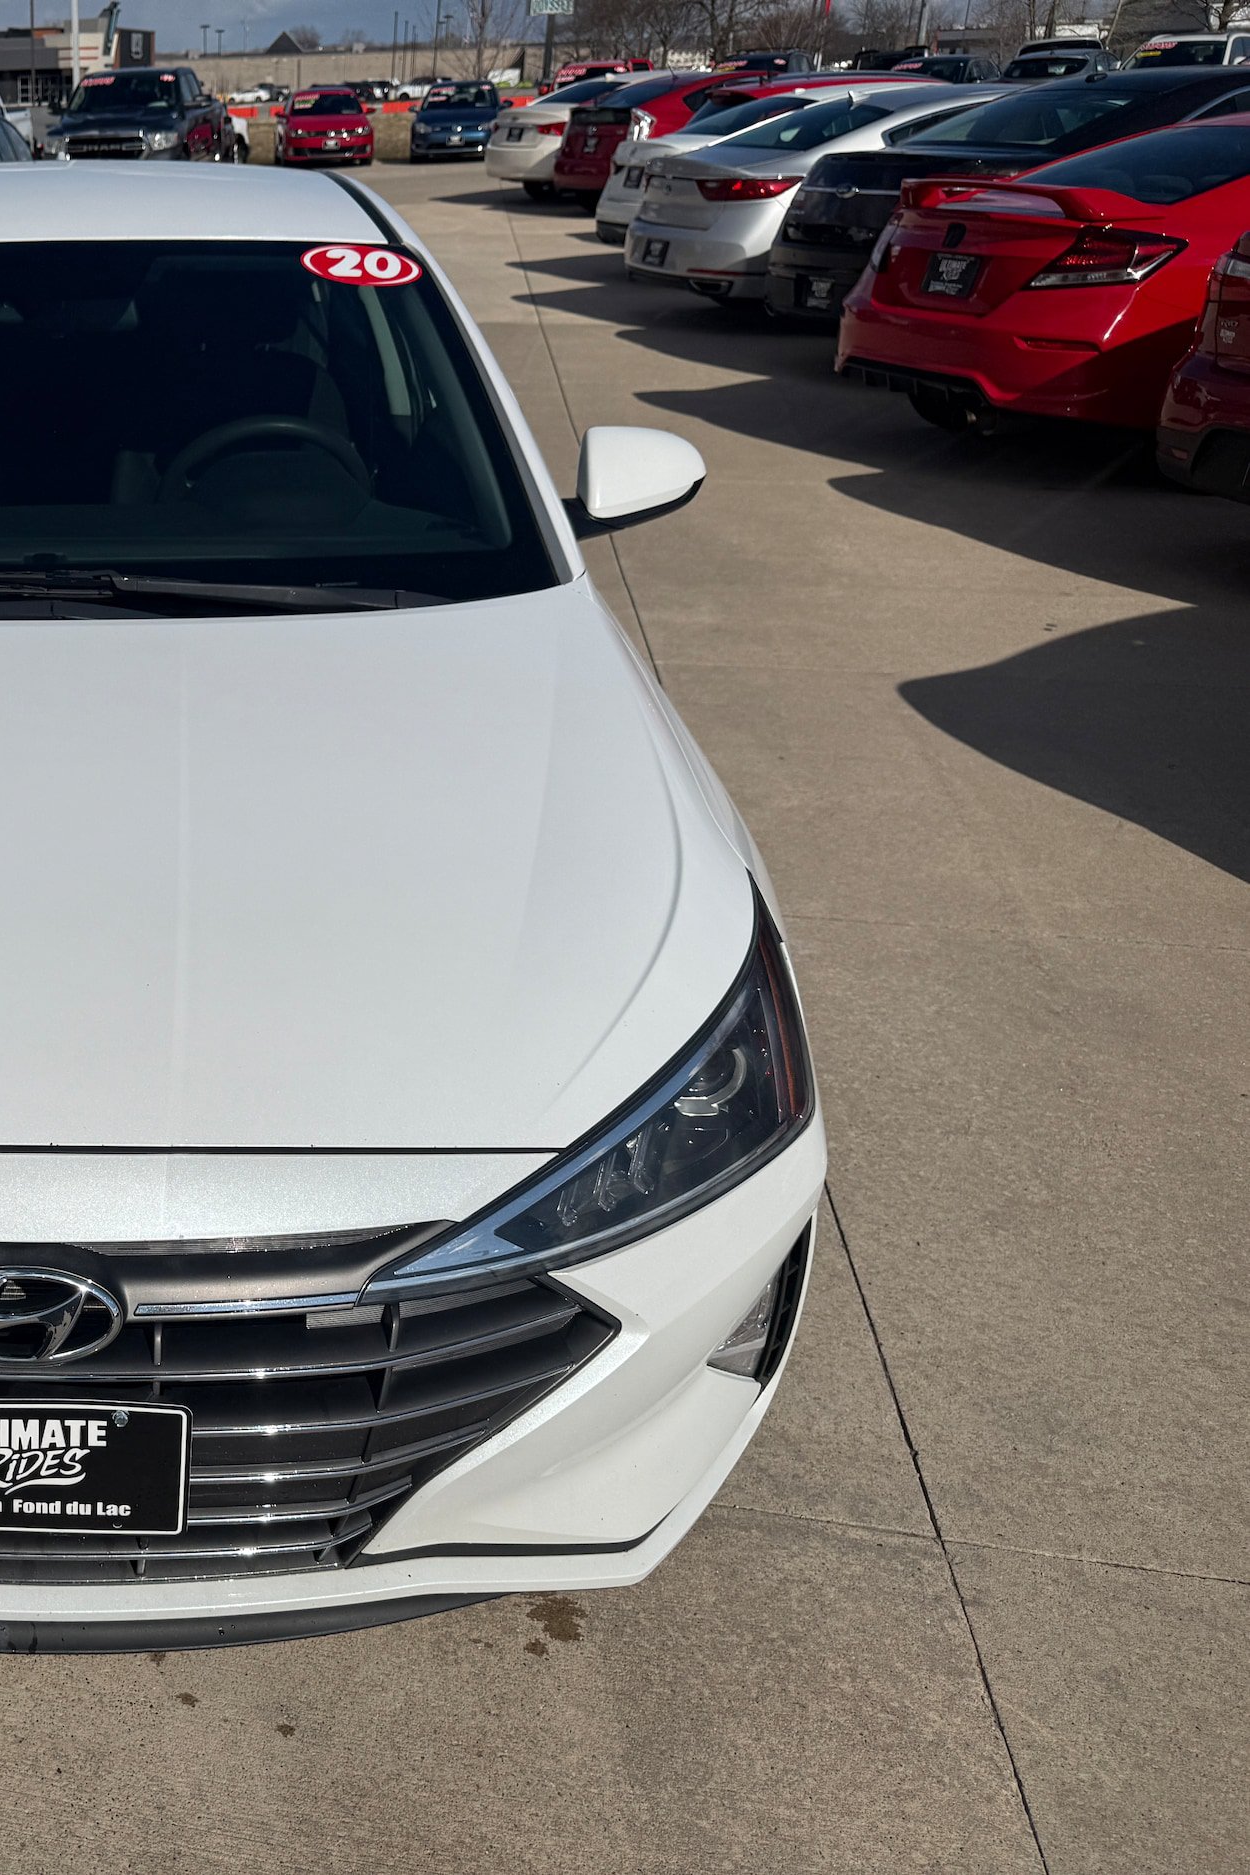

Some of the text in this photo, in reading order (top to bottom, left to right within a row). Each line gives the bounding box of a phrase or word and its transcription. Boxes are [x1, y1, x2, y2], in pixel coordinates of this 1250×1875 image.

[325, 248, 402, 279] 20
[13, 1499, 61, 1514] Fond
[66, 1501, 92, 1516] du
[96, 1502, 131, 1516] Lac
